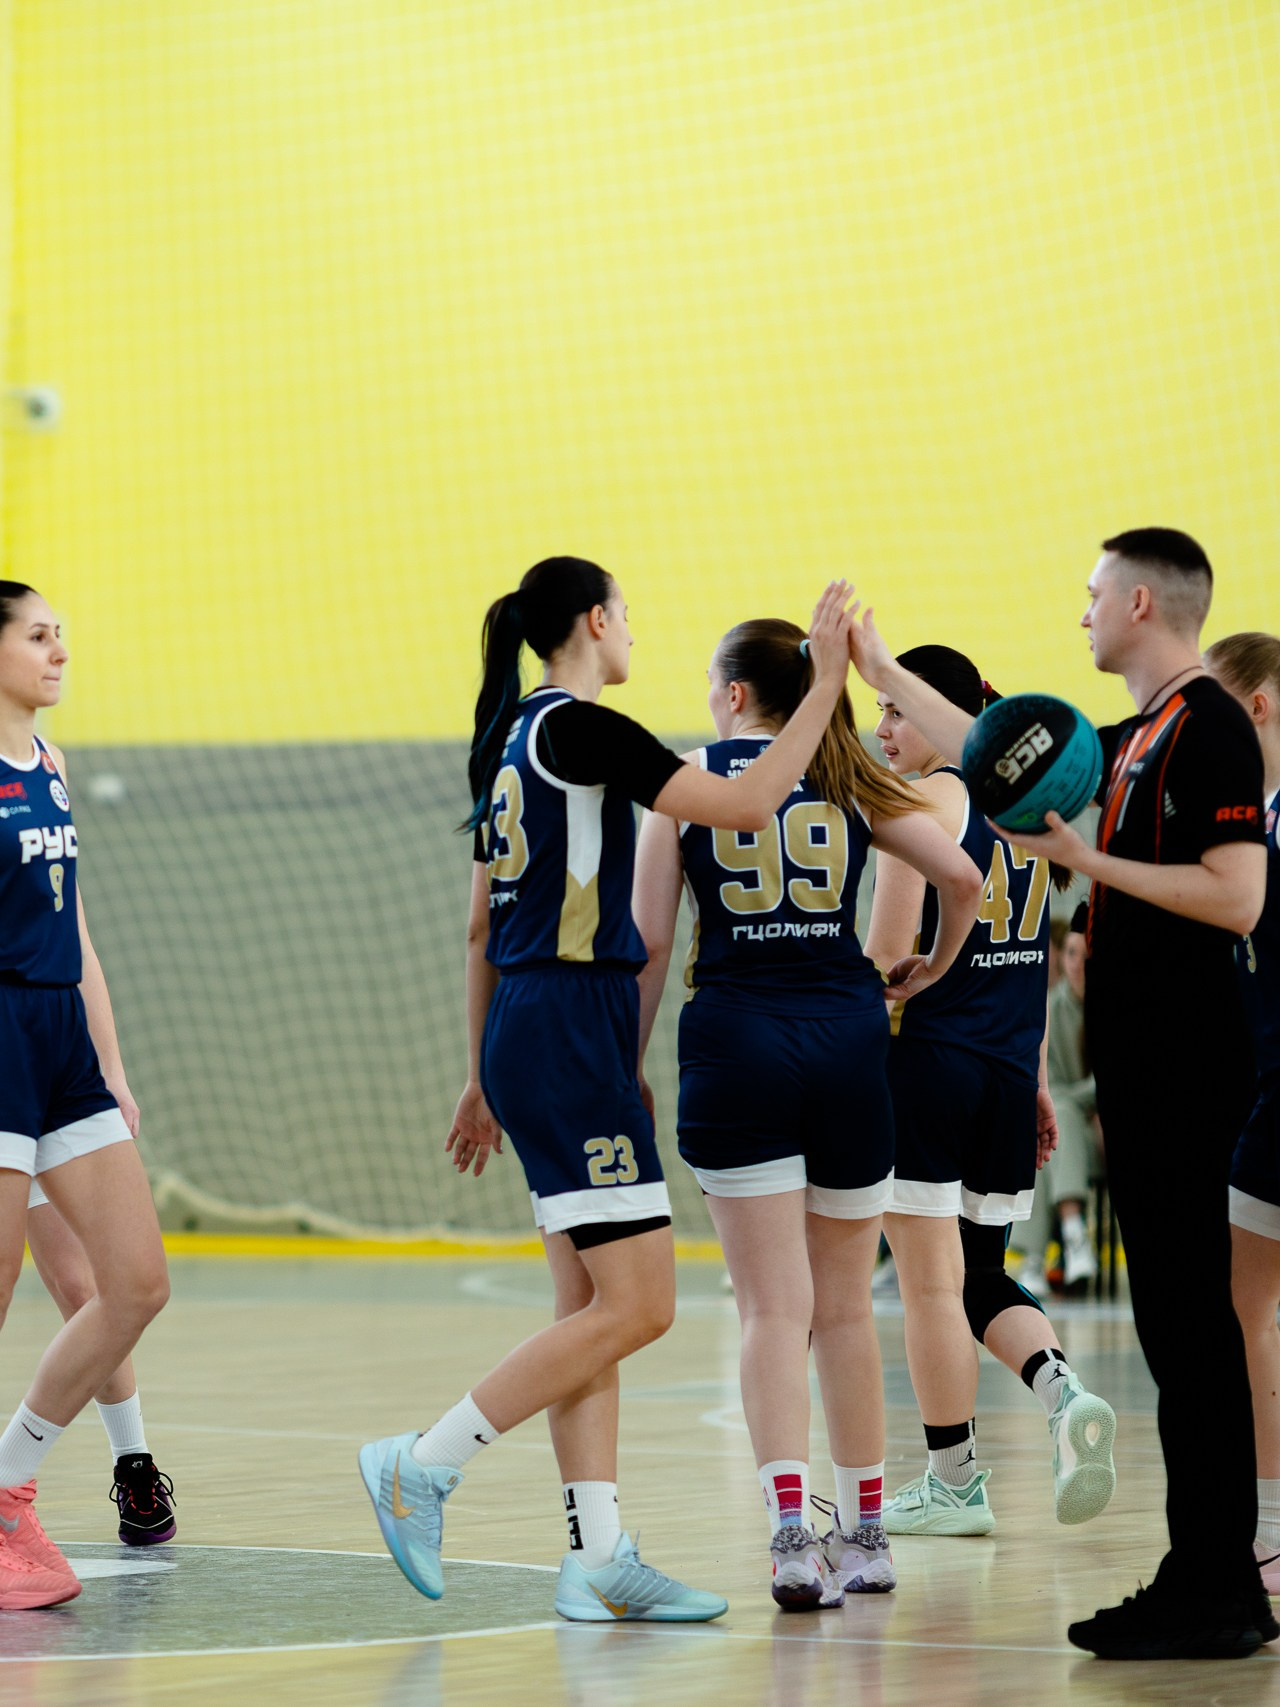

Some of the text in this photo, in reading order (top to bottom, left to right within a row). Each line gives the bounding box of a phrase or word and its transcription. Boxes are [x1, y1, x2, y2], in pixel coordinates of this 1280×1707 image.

[712, 801, 848, 914] 99
[49, 863, 65, 912] 9
[977, 840, 1050, 943] 47
[732, 922, 841, 941] ГЦОЛИФК
[584, 1135, 639, 1186] 23
